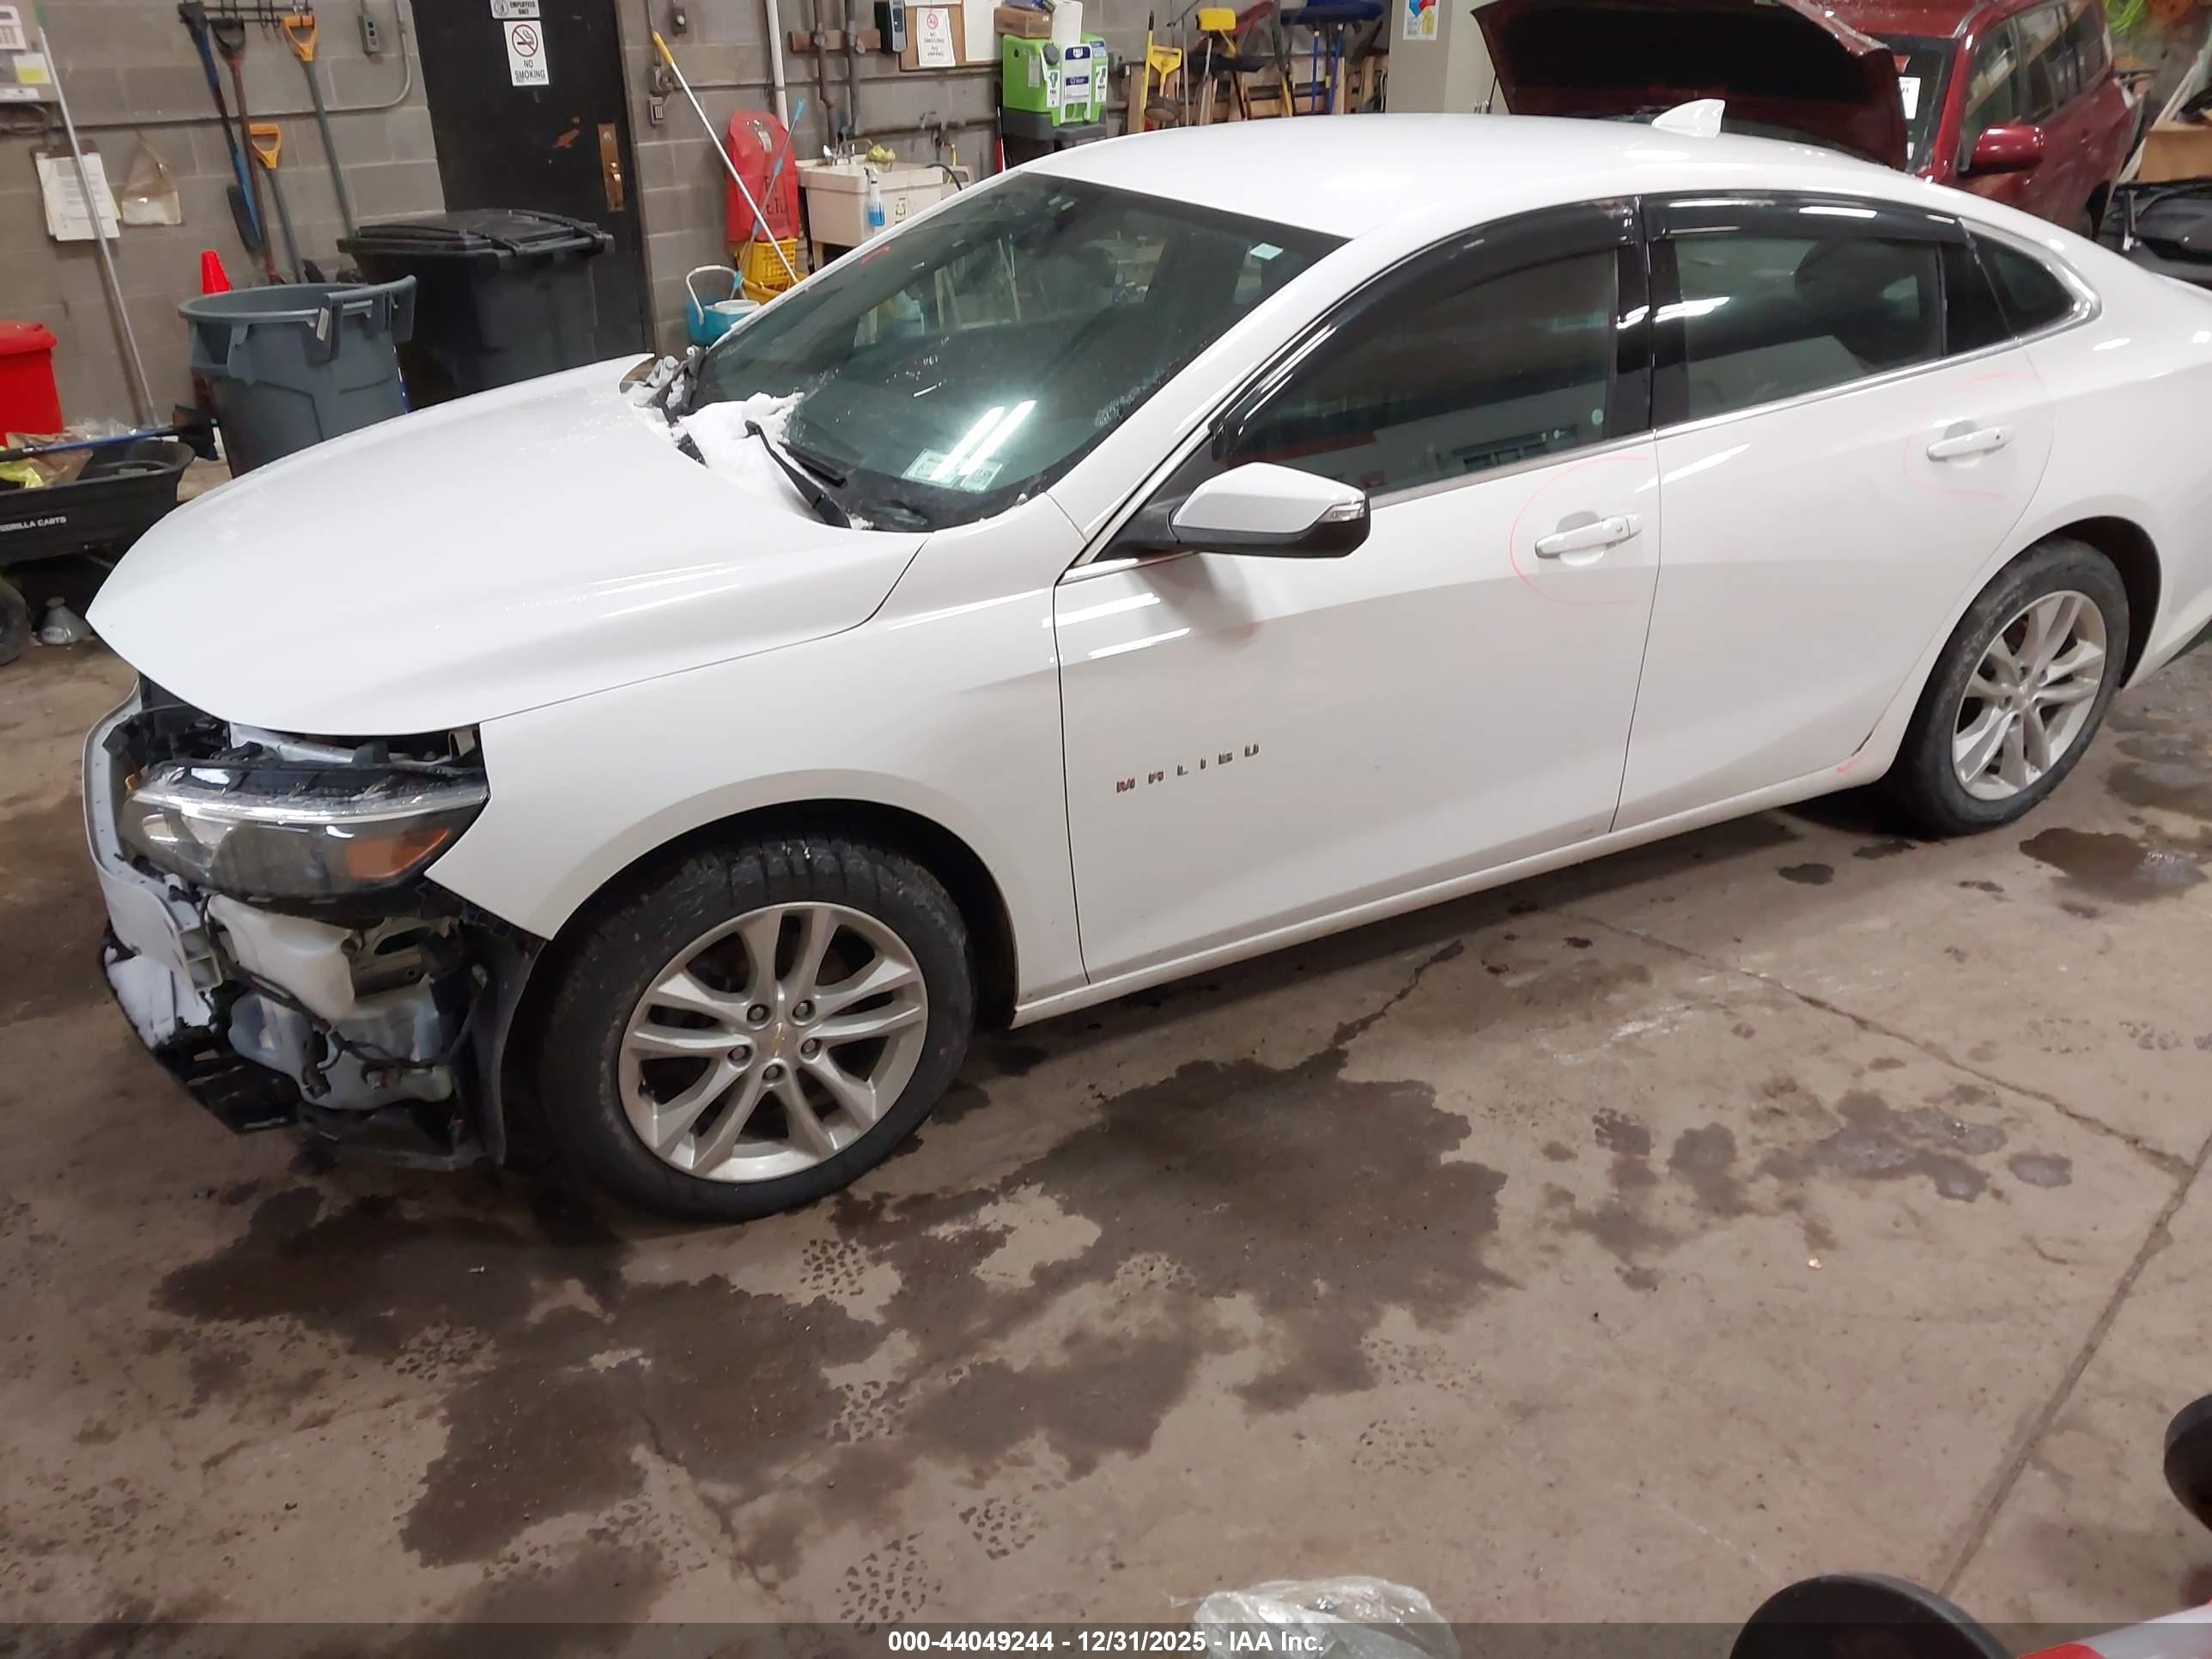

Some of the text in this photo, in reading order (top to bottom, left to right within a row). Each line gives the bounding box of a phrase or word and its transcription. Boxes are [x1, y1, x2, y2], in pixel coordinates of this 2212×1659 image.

[524, 59, 533, 68] NO
[514, 70, 545, 79] SMOKING
[1115, 743, 1261, 793] MALIBU
